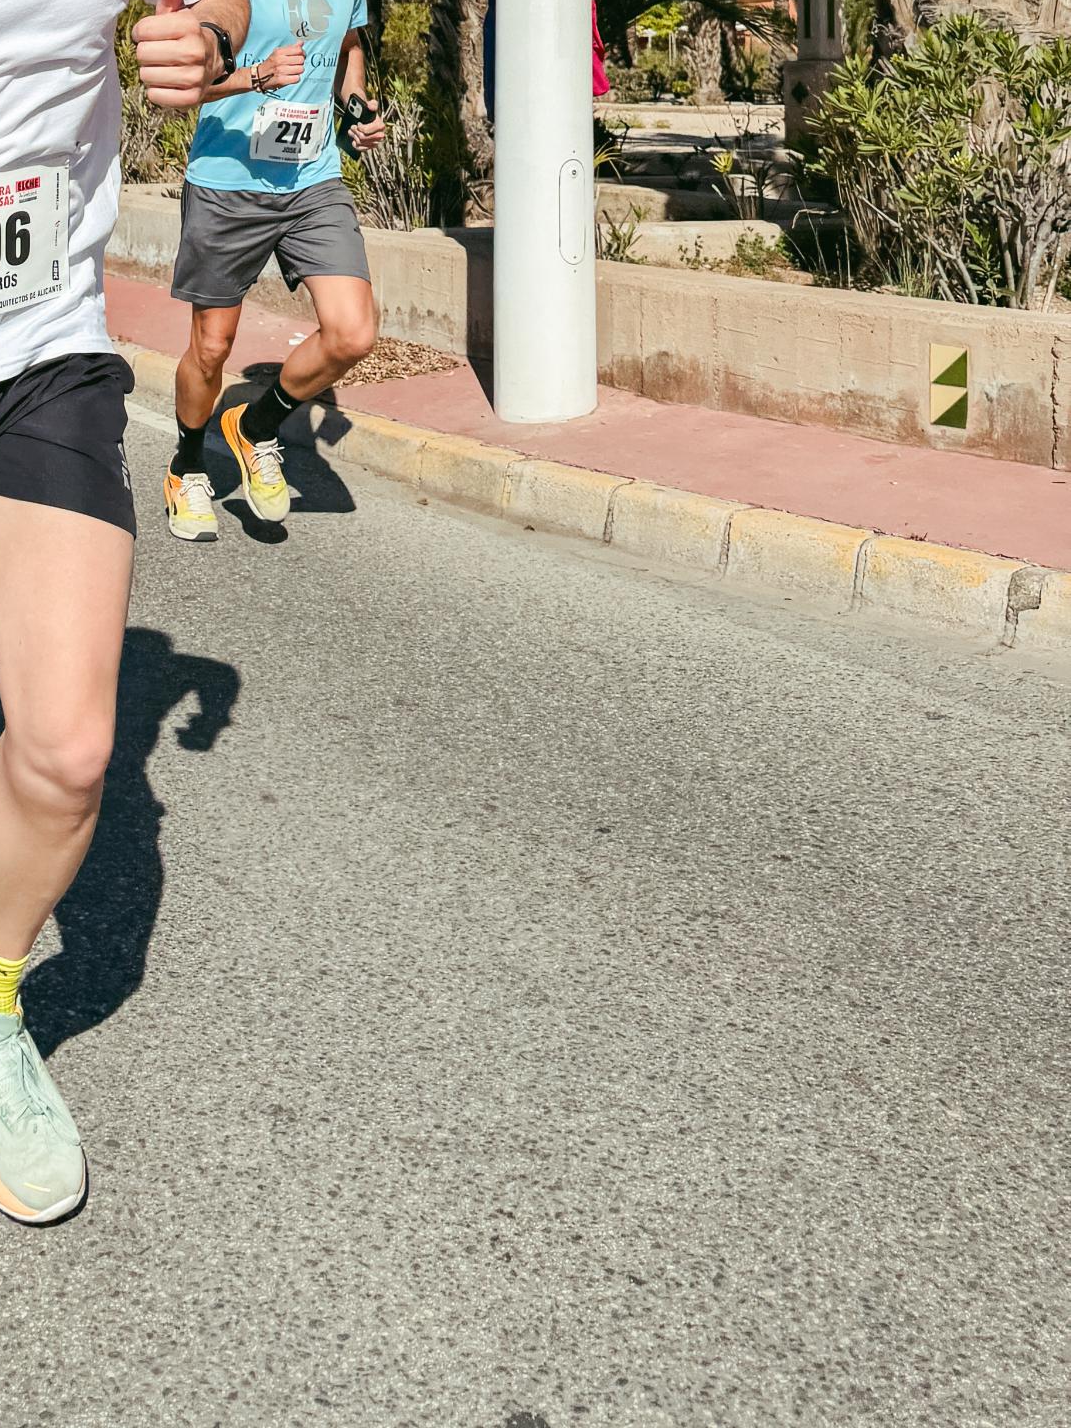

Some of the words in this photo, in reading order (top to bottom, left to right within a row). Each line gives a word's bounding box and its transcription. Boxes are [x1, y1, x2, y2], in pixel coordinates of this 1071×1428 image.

[274, 120, 313, 145] 274
[17, 178, 39, 191] ELCHE
[29, 291, 36, 300] DE
[37, 283, 62, 297] ALICANTE
